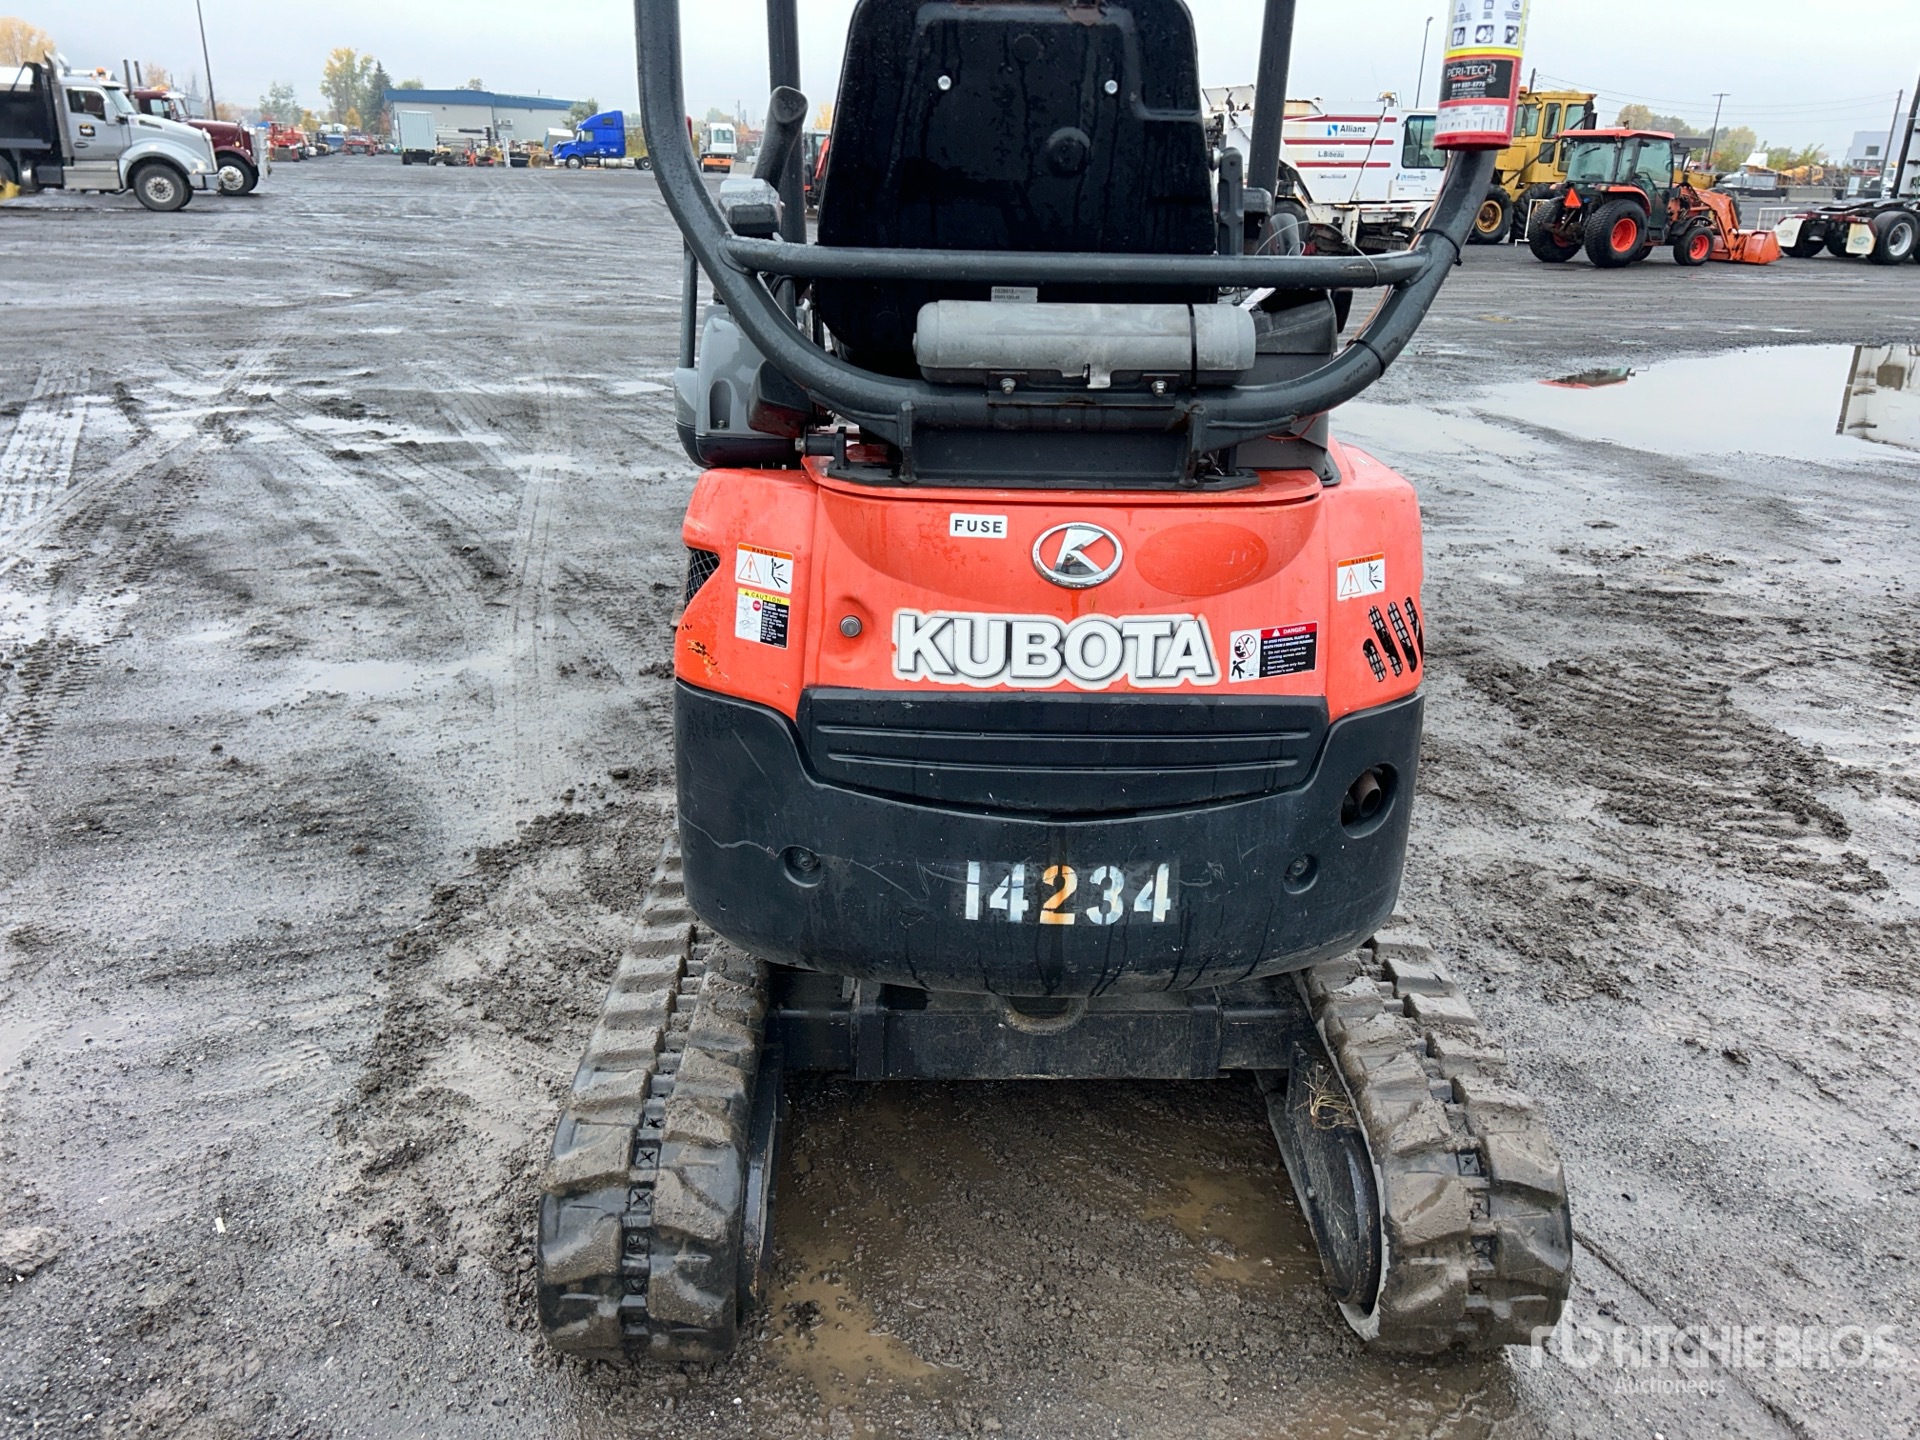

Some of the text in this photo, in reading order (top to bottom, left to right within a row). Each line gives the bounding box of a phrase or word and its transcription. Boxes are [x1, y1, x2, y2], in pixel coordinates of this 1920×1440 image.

[1340, 125, 1366, 133] Allianz
[953, 519, 1004, 533] FUSE
[751, 547, 778, 557] WARNING
[1351, 556, 1374, 565] WARNING
[751, 592, 782, 603] CAUTION
[1283, 626, 1306, 634] DANGER
[898, 614, 1214, 681] KUBOTA
[965, 861, 1171, 925] 14234
